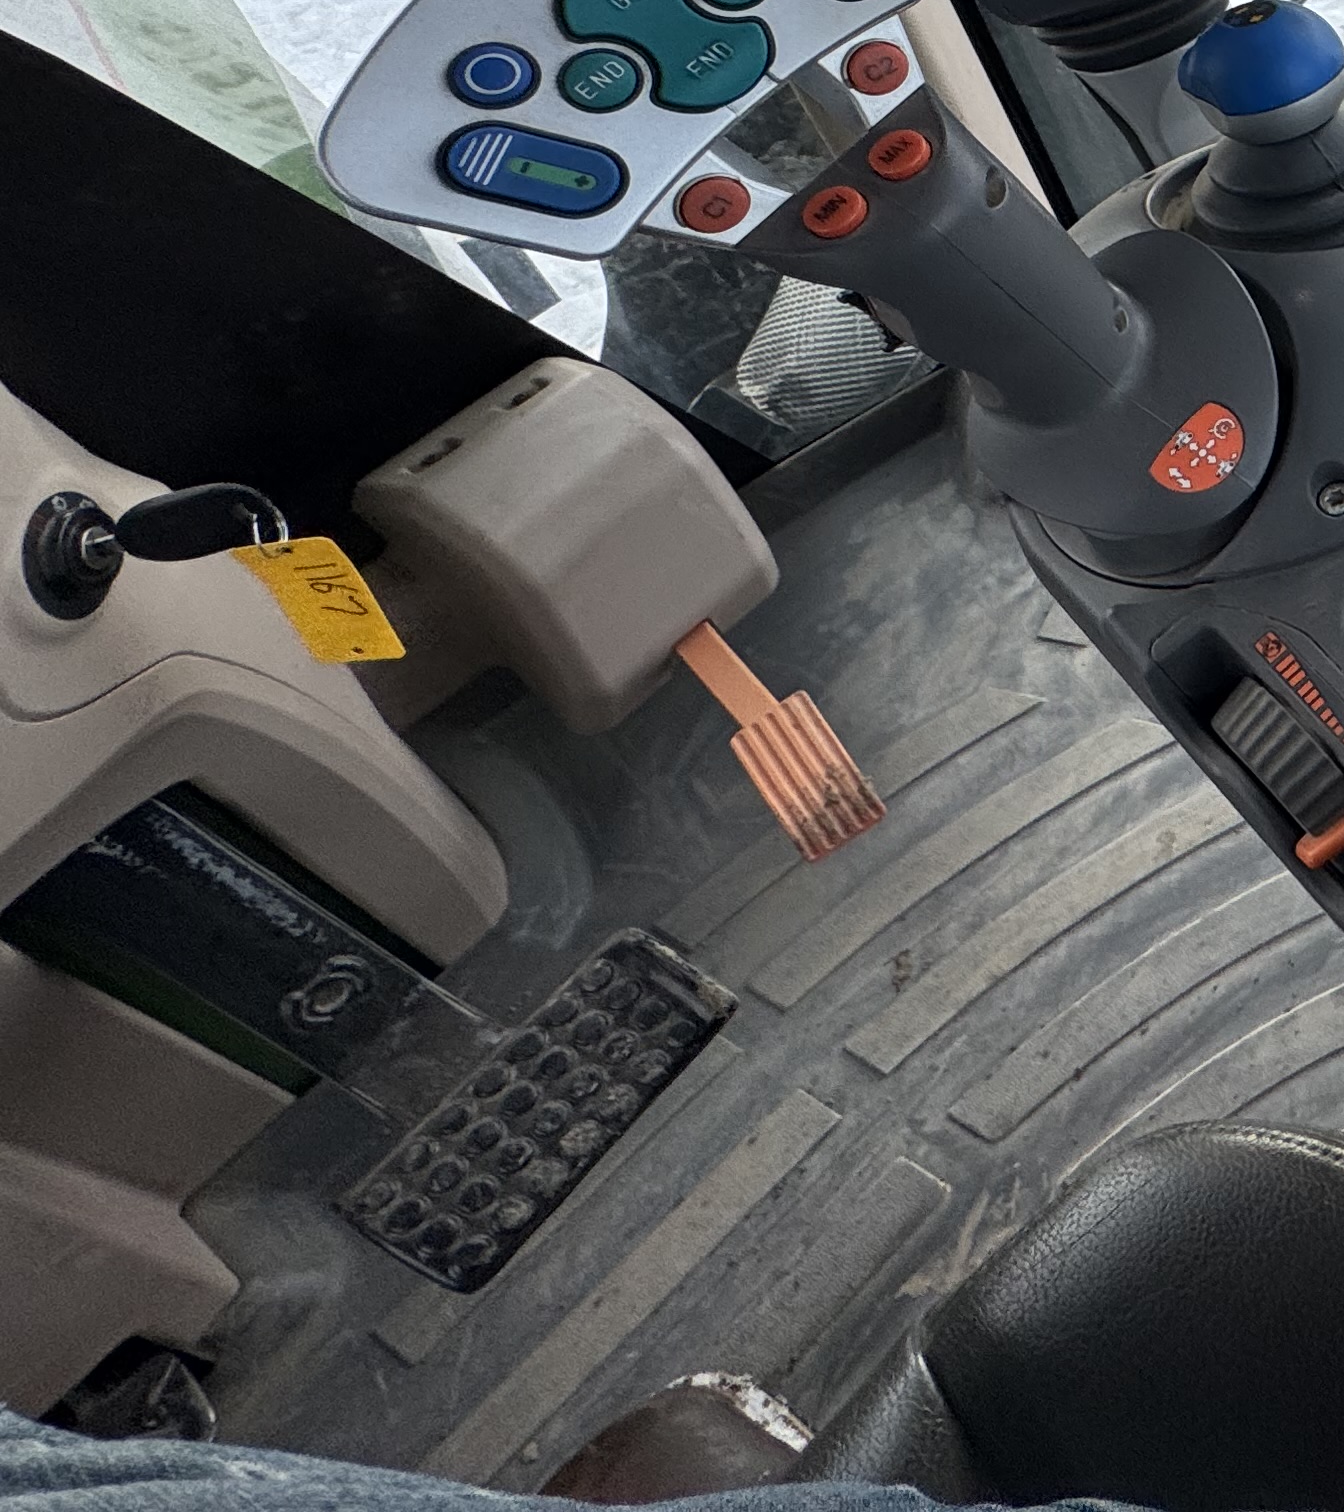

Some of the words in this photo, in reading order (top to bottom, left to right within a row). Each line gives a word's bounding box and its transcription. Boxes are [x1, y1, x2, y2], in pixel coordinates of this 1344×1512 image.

[686, 41, 735, 79] END
[863, 56, 899, 82] C2
[574, 61, 625, 100] END
[878, 136, 913, 166] MAX
[702, 195, 733, 220] C1
[813, 193, 848, 223] MIN
